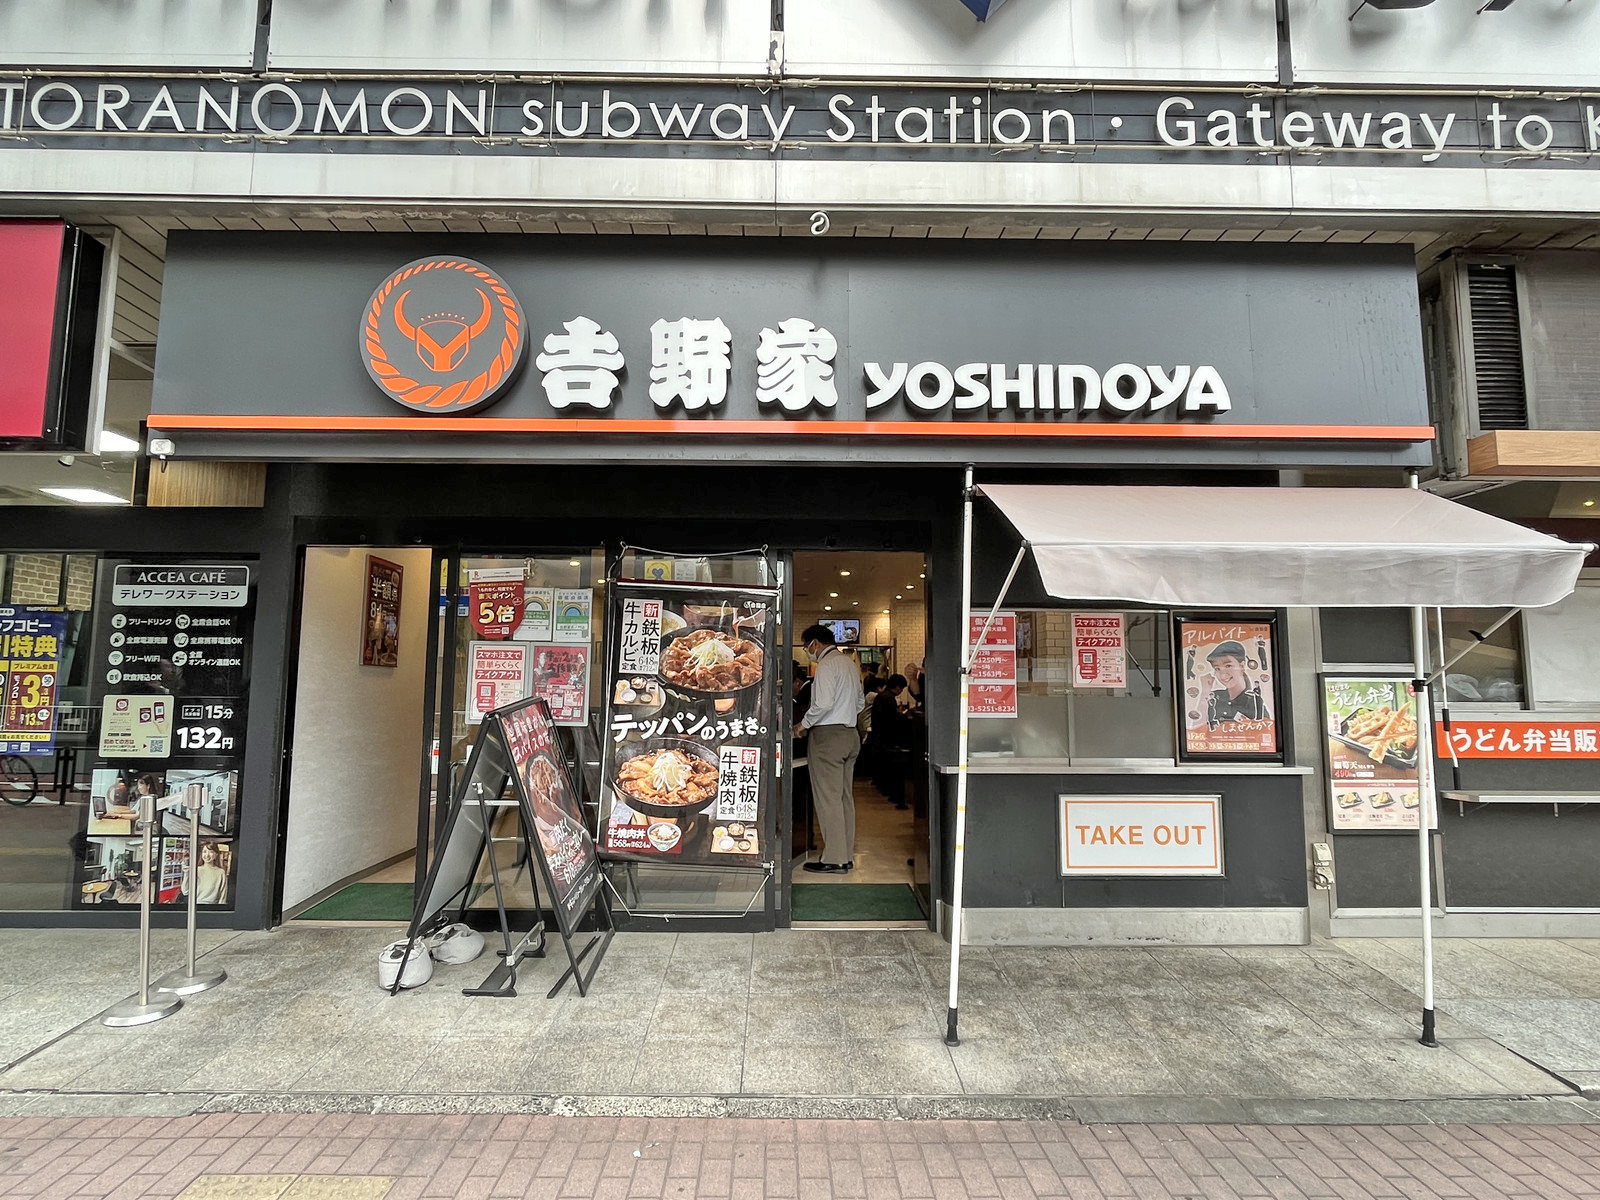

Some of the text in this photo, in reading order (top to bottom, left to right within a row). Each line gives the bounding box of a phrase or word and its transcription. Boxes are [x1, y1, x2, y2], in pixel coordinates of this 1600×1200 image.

[0, 82, 487, 137] TORANOMON
[521, 89, 794, 153] subway
[825, 94, 1076, 146] Station
[1156, 96, 1456, 162] Gateway
[1487, 103, 1553, 151] to
[863, 361, 1232, 411] YOSHINOYA
[137, 569, 226, 583] ACCEA CAFÉ
[120, 589, 240, 600] テレワークステーション
[479, 601, 515, 624] 5倍
[0, 618, 52, 632] フコピー
[128, 618, 172, 626] フリードリンク
[1076, 619, 1119, 627] スマホ注文で
[622, 601, 641, 662] 牛カルビ
[1183, 626, 1247, 644] アルバイト
[1077, 638, 1120, 646] テイクアウト
[477, 651, 521, 659] スマホ注文で
[477, 661, 520, 669] 簡単らくらく
[476, 671, 520, 680] テイクアウト
[1331, 684, 1395, 711] うどん弁当
[205, 705, 234, 719] 15分
[611, 712, 768, 742] テッパンのうまさ。
[176, 726, 234, 750] 132円
[1452, 728, 1600, 753] うどん弁当販
[1075, 824, 1207, 845] TAKE OUT
